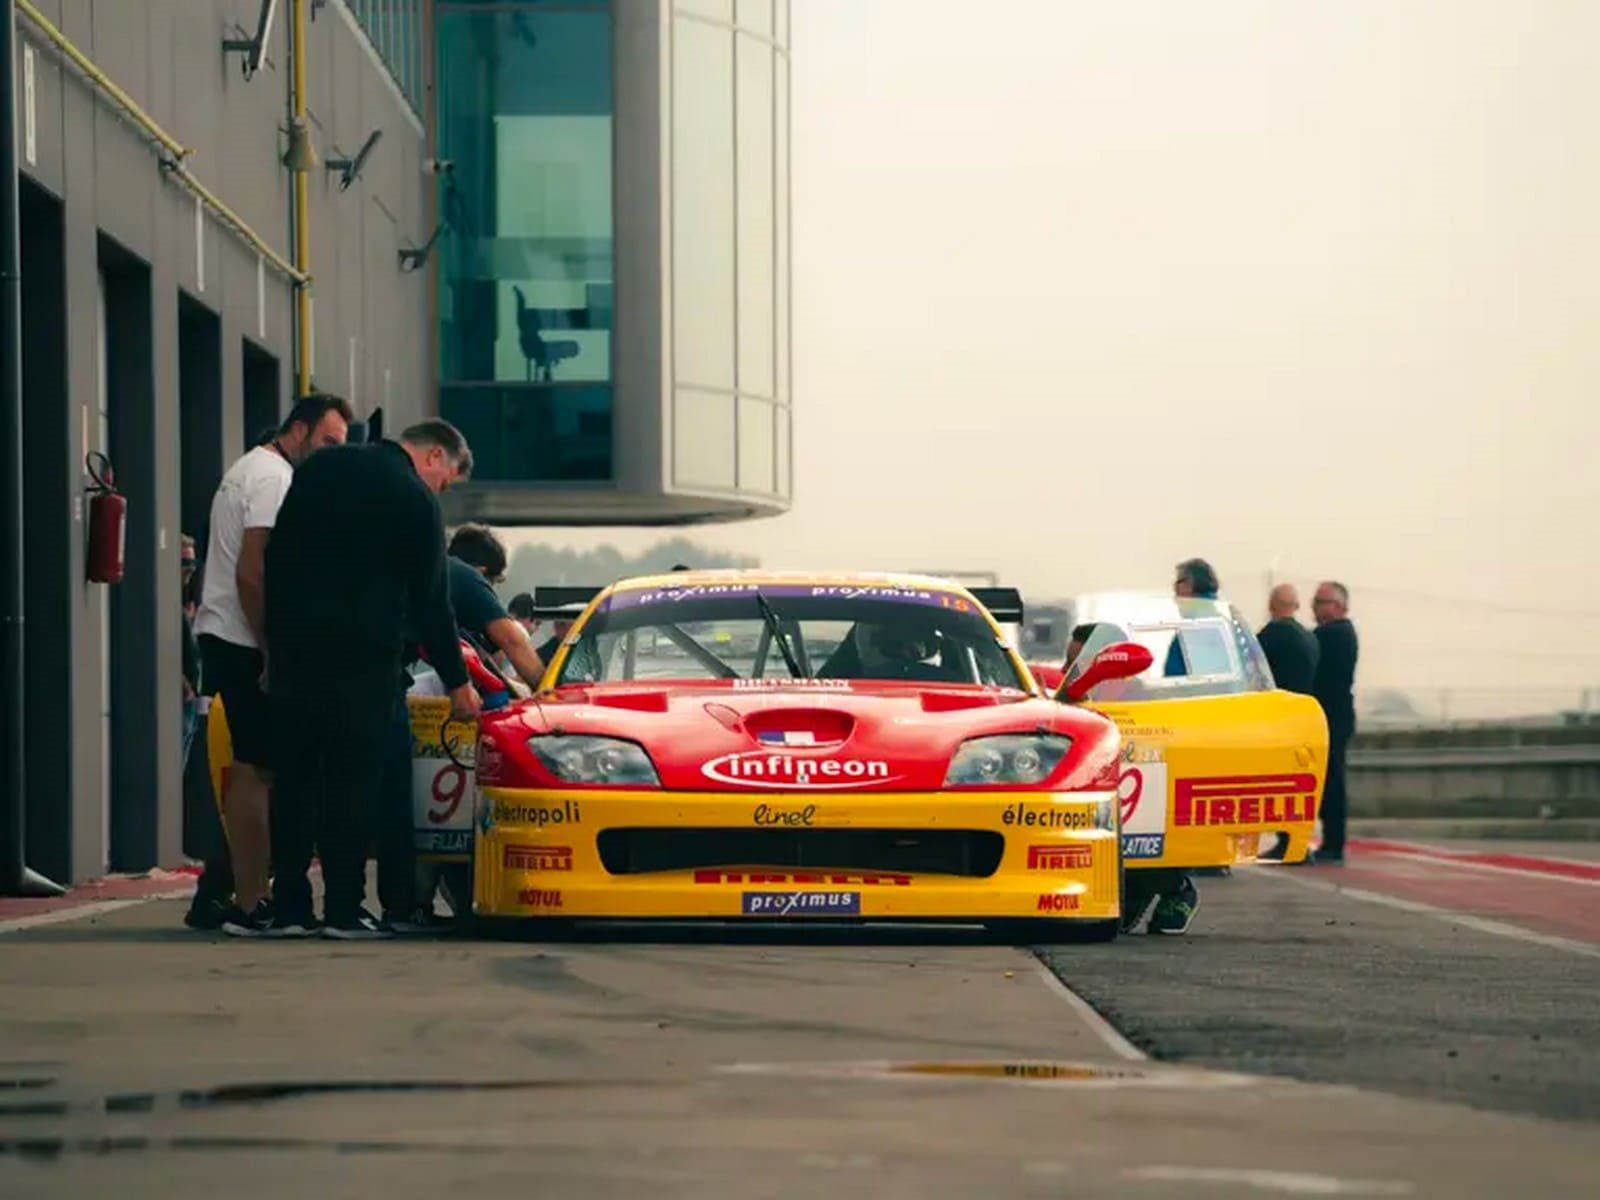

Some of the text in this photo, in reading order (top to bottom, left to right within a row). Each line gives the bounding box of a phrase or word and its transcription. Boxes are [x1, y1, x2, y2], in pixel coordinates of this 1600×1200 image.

[811, 585, 932, 600] proximus
[729, 754, 889, 777] infineon
[428, 763, 466, 824] 9
[1174, 773, 1317, 826] PIRELLI
[754, 804, 816, 826] linel
[504, 844, 573, 871] PIRELLI
[1027, 845, 1092, 869] PIRELLI
[751, 891, 852, 915] proximus
